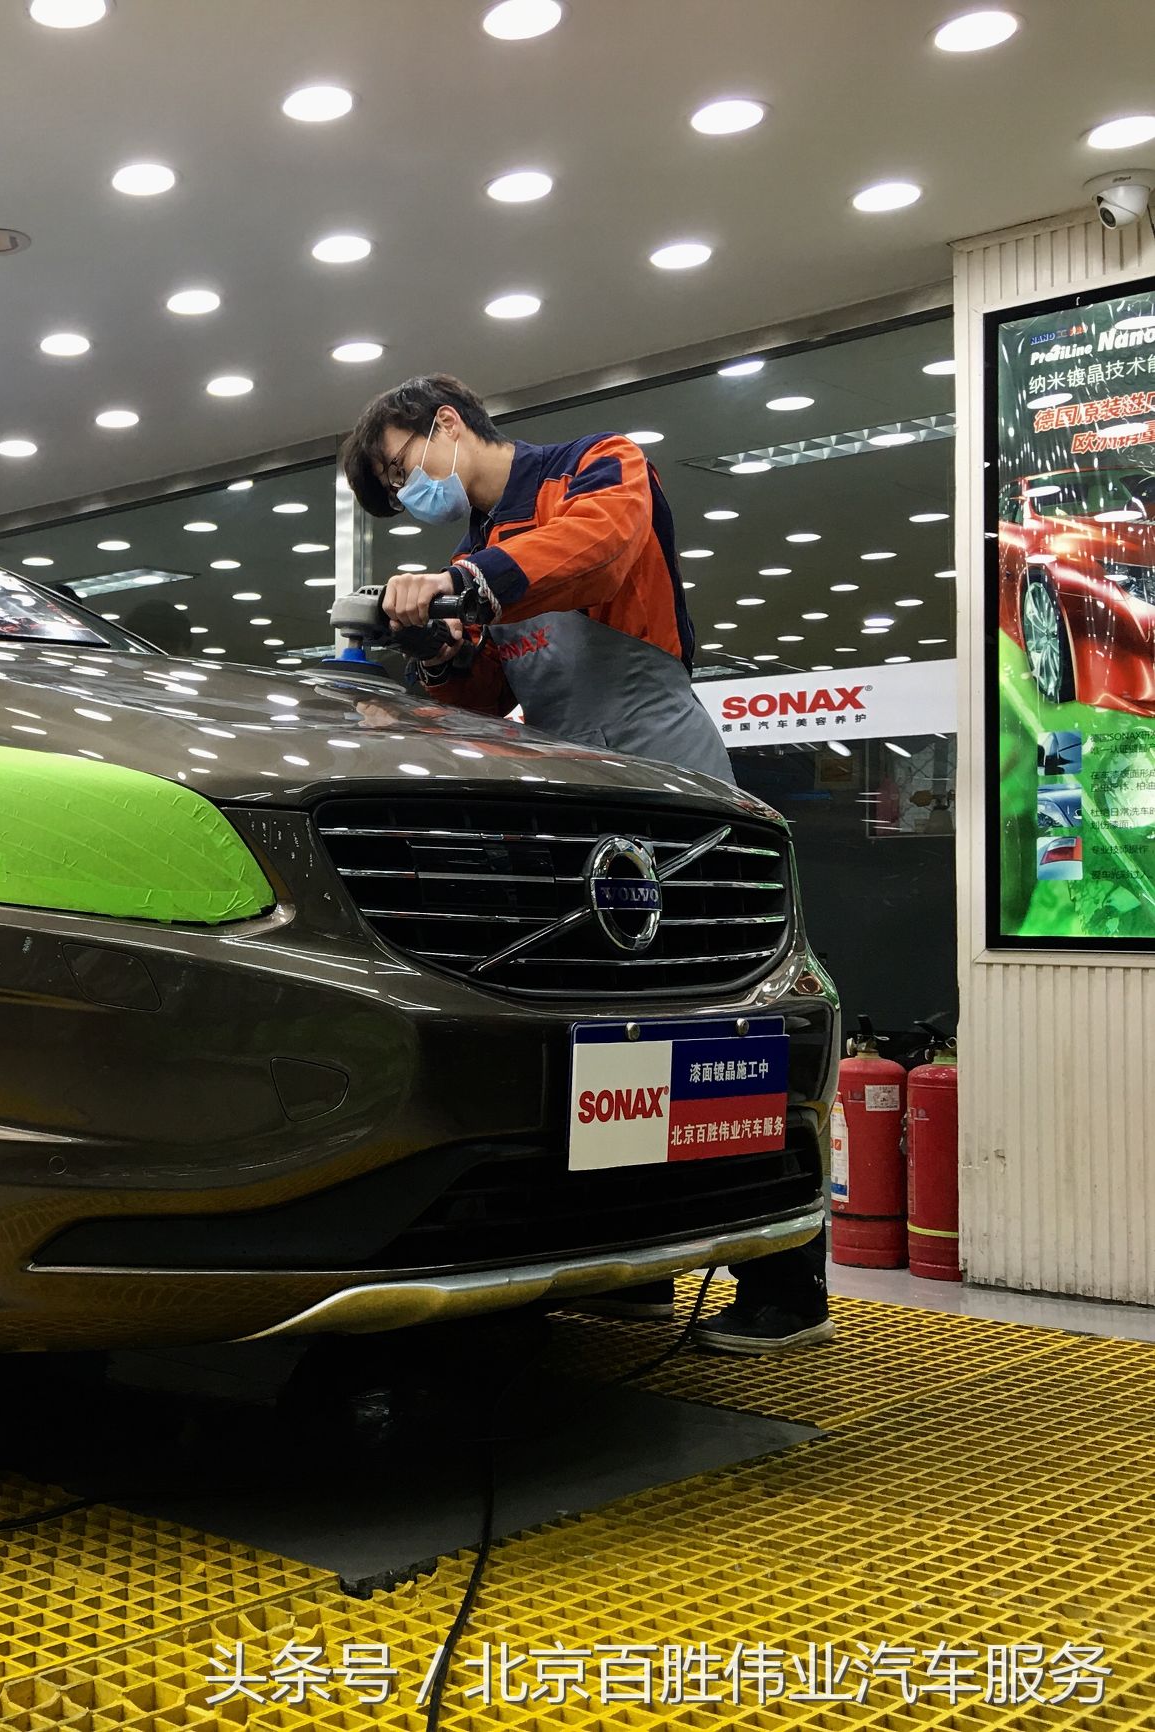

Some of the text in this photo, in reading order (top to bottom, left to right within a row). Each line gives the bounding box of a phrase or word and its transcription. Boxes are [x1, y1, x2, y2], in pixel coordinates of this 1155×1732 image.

[721, 714, 867, 732] 德国汽车美容养护
[600, 887, 659, 902] VOLVO
[689, 1058, 769, 1083] 漆面镀晶施工中
[670, 1116, 784, 1146] 北京百胜伟业汽车服务
